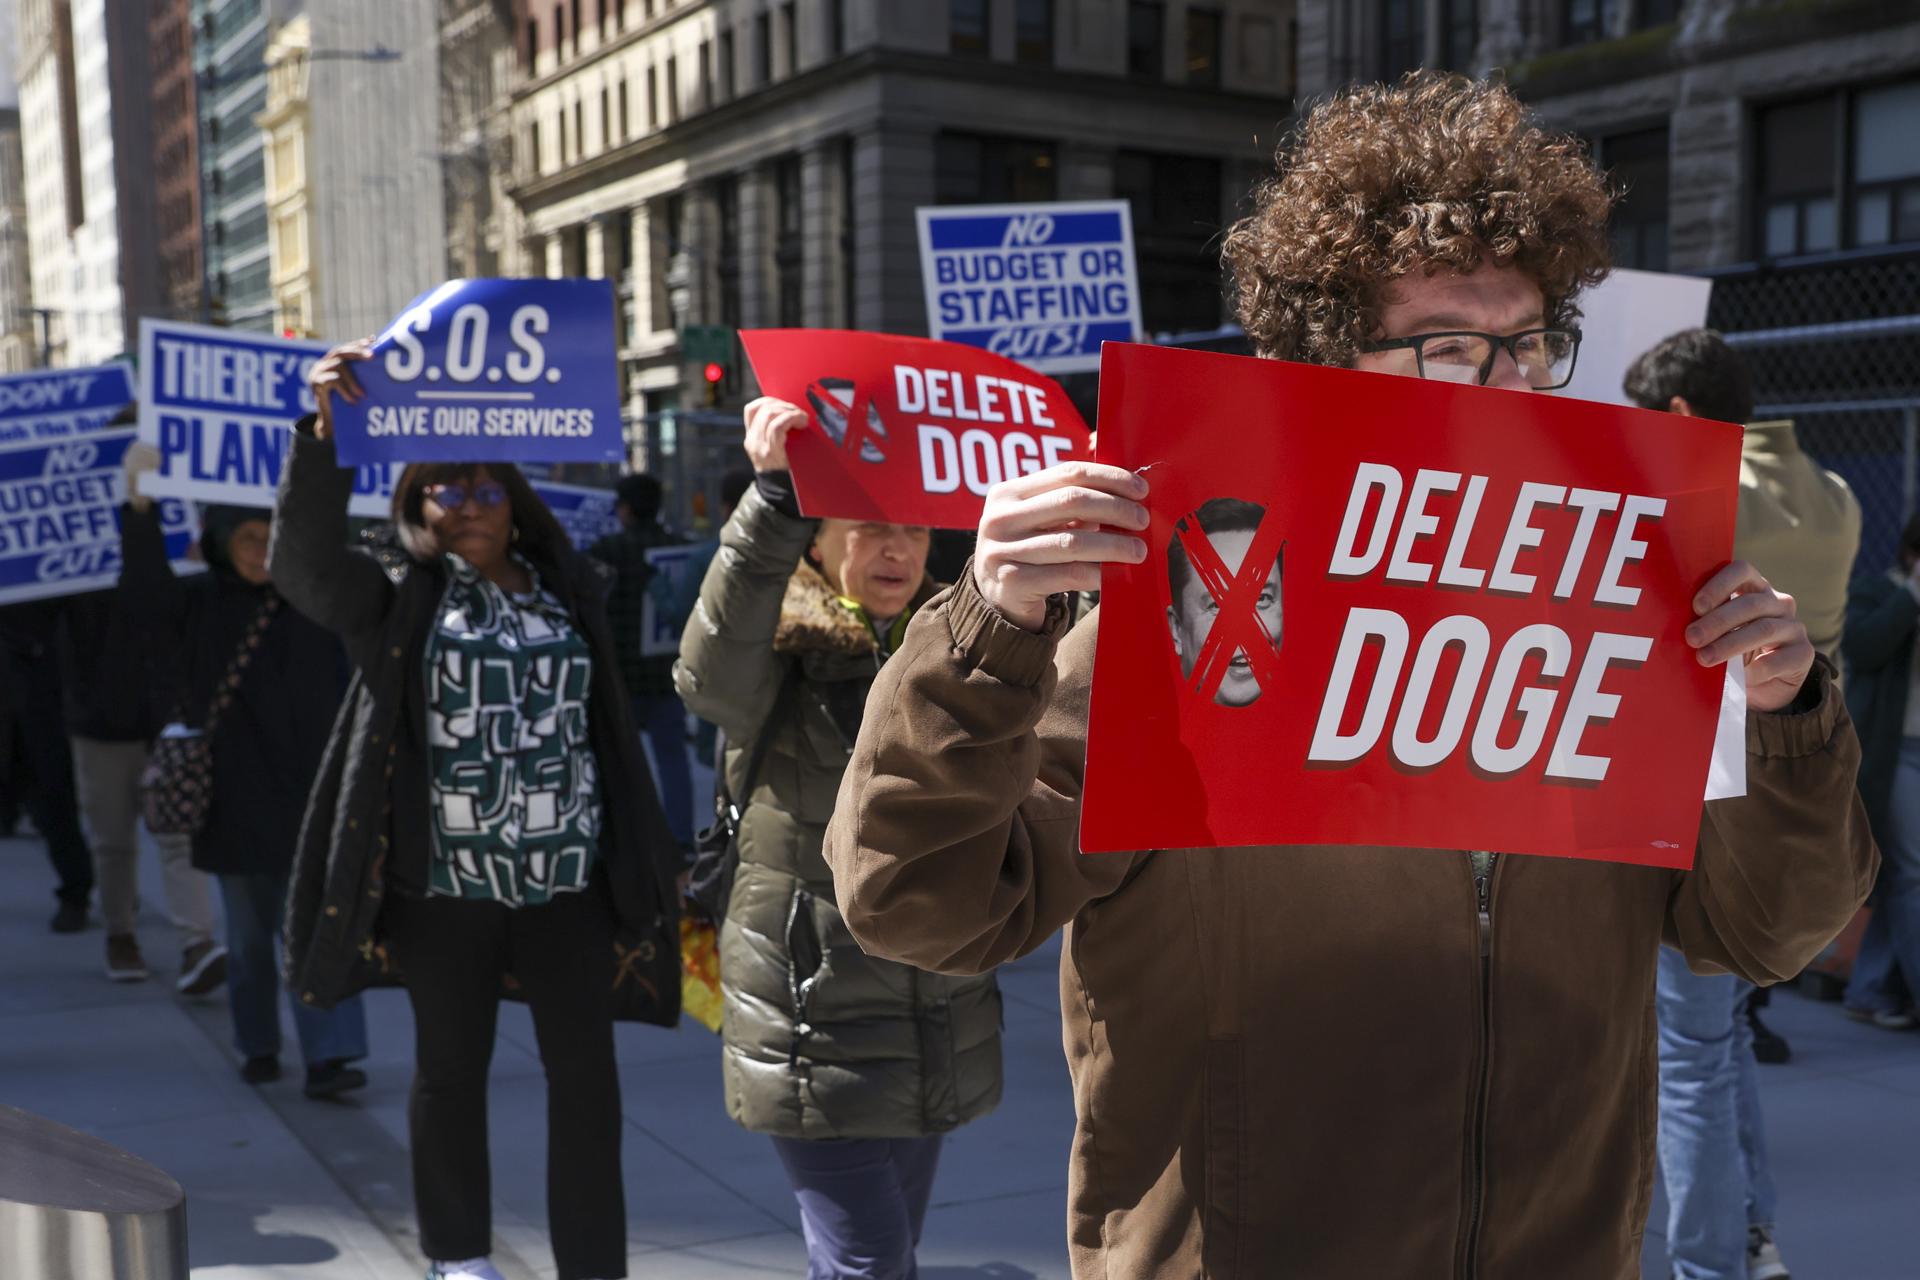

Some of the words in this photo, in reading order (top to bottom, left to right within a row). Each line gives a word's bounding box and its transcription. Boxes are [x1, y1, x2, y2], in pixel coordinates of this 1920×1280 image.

[1001, 214, 1055, 248] NO
[936, 252, 1066, 284] BUDGET
[1080, 249, 1124, 277] OR
[938, 282, 1128, 324] STAFFING
[385, 303, 561, 383] S.O.S.
[987, 325, 1089, 356] CUTS!
[894, 365, 1055, 428] DELETE
[367, 407, 428, 437] SAVE
[434, 407, 480, 436] OUR
[484, 408, 594, 437] SERVICES
[43, 441, 98, 478] NO
[160, 415, 292, 487] PLAN
[0, 473, 115, 513] UDGET
[1328, 462, 1667, 606] DELETE
[1308, 607, 1653, 781] DOGE
